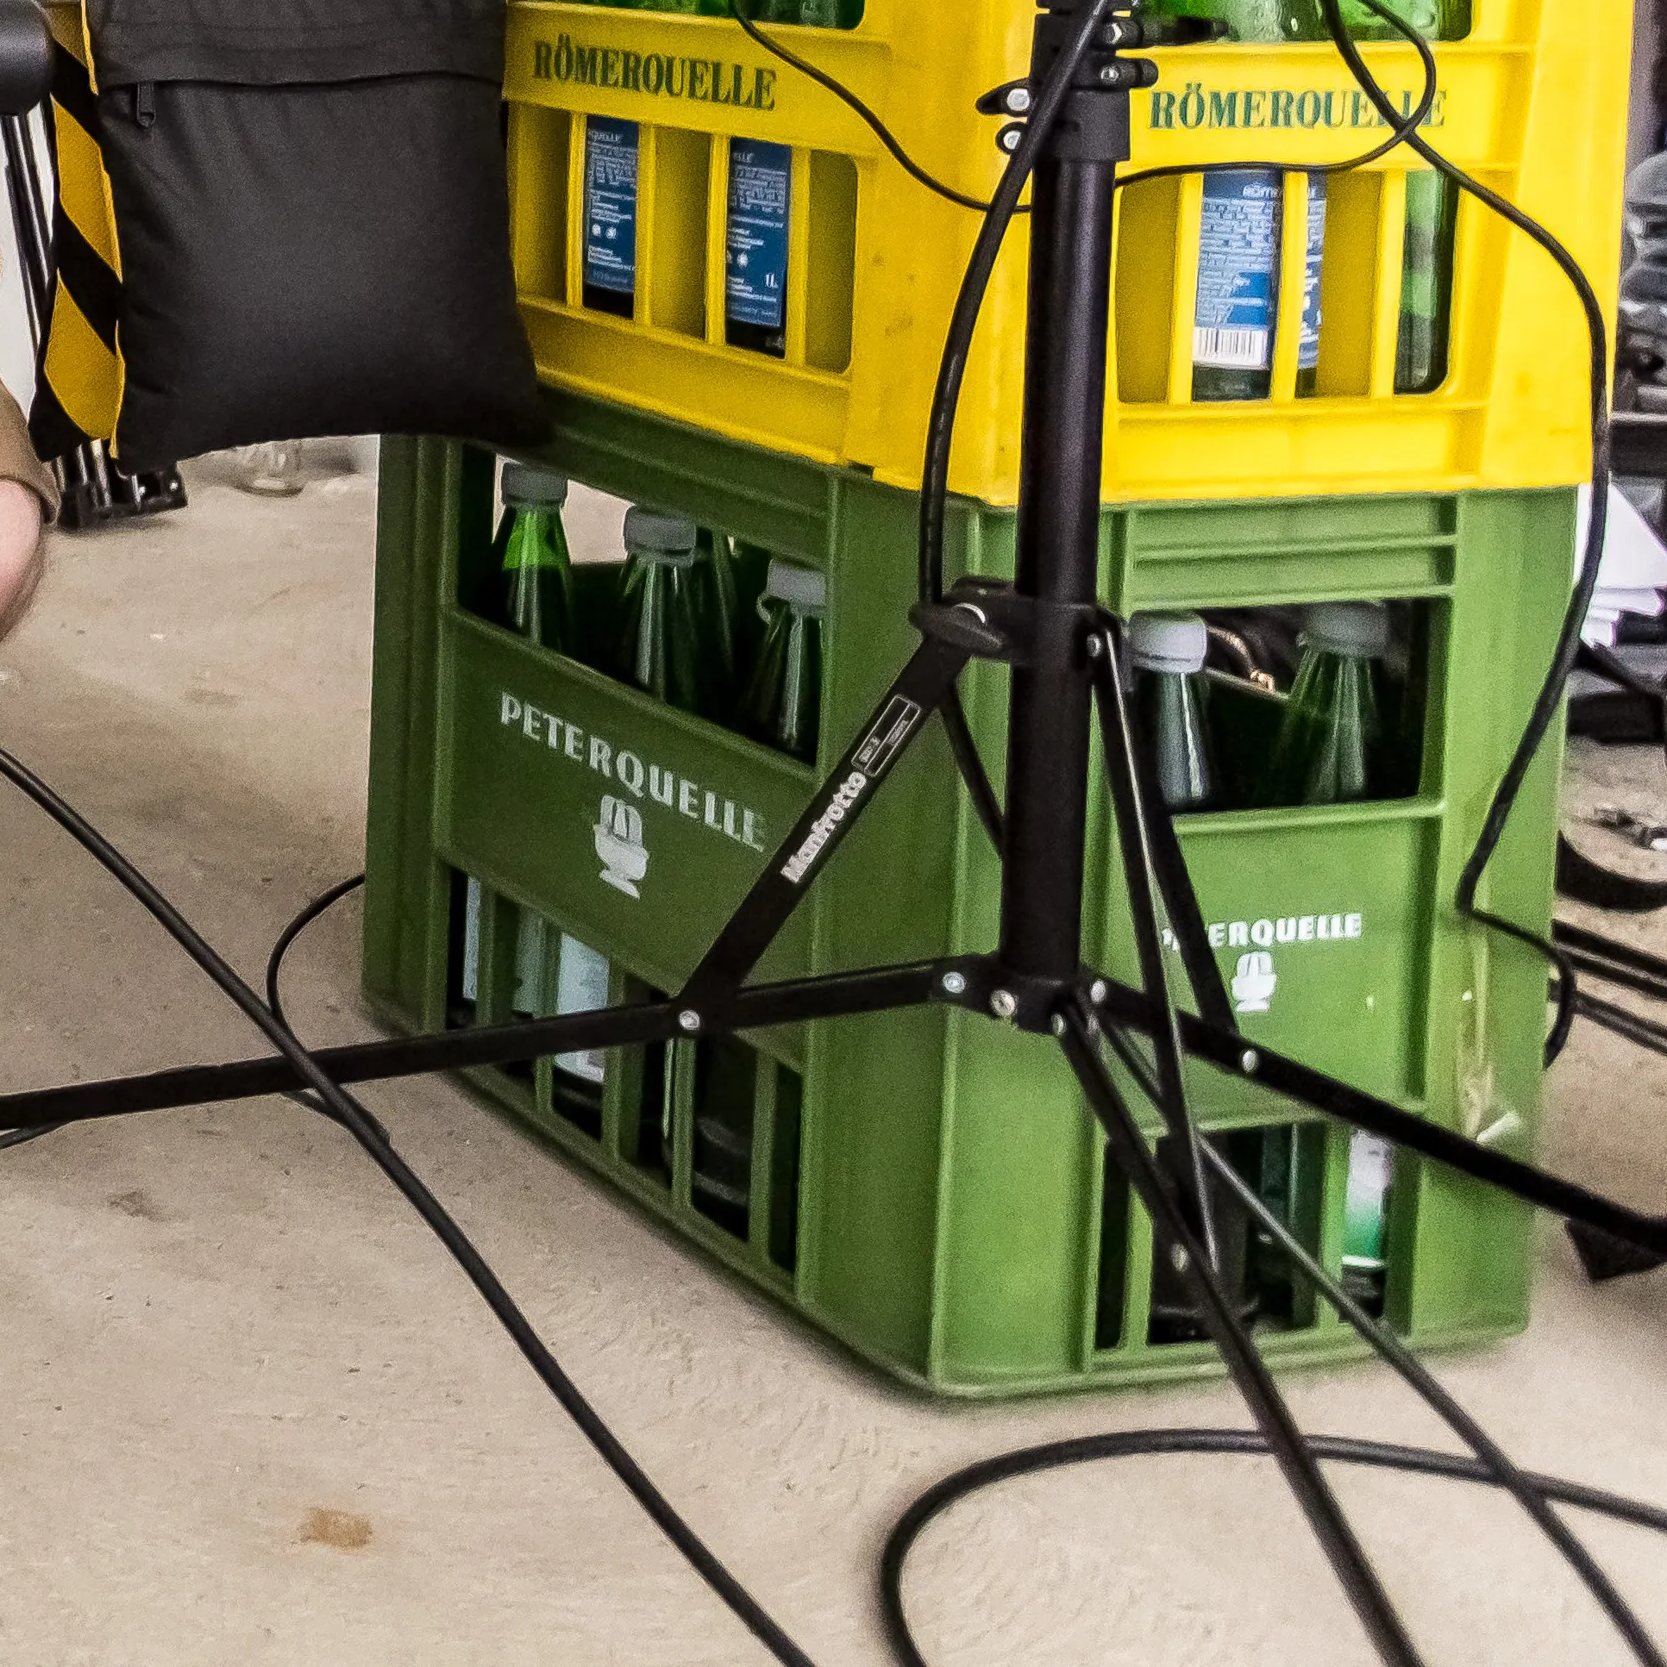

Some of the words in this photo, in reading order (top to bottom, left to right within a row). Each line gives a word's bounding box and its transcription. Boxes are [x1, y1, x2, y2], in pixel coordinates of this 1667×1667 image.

[532, 33, 778, 112] RÖMERQUELLE
[500, 690, 766, 854] PETERQUELLE
[780, 771, 867, 884] Manfrotto
[1162, 912, 1362, 952] ERQUELLE
